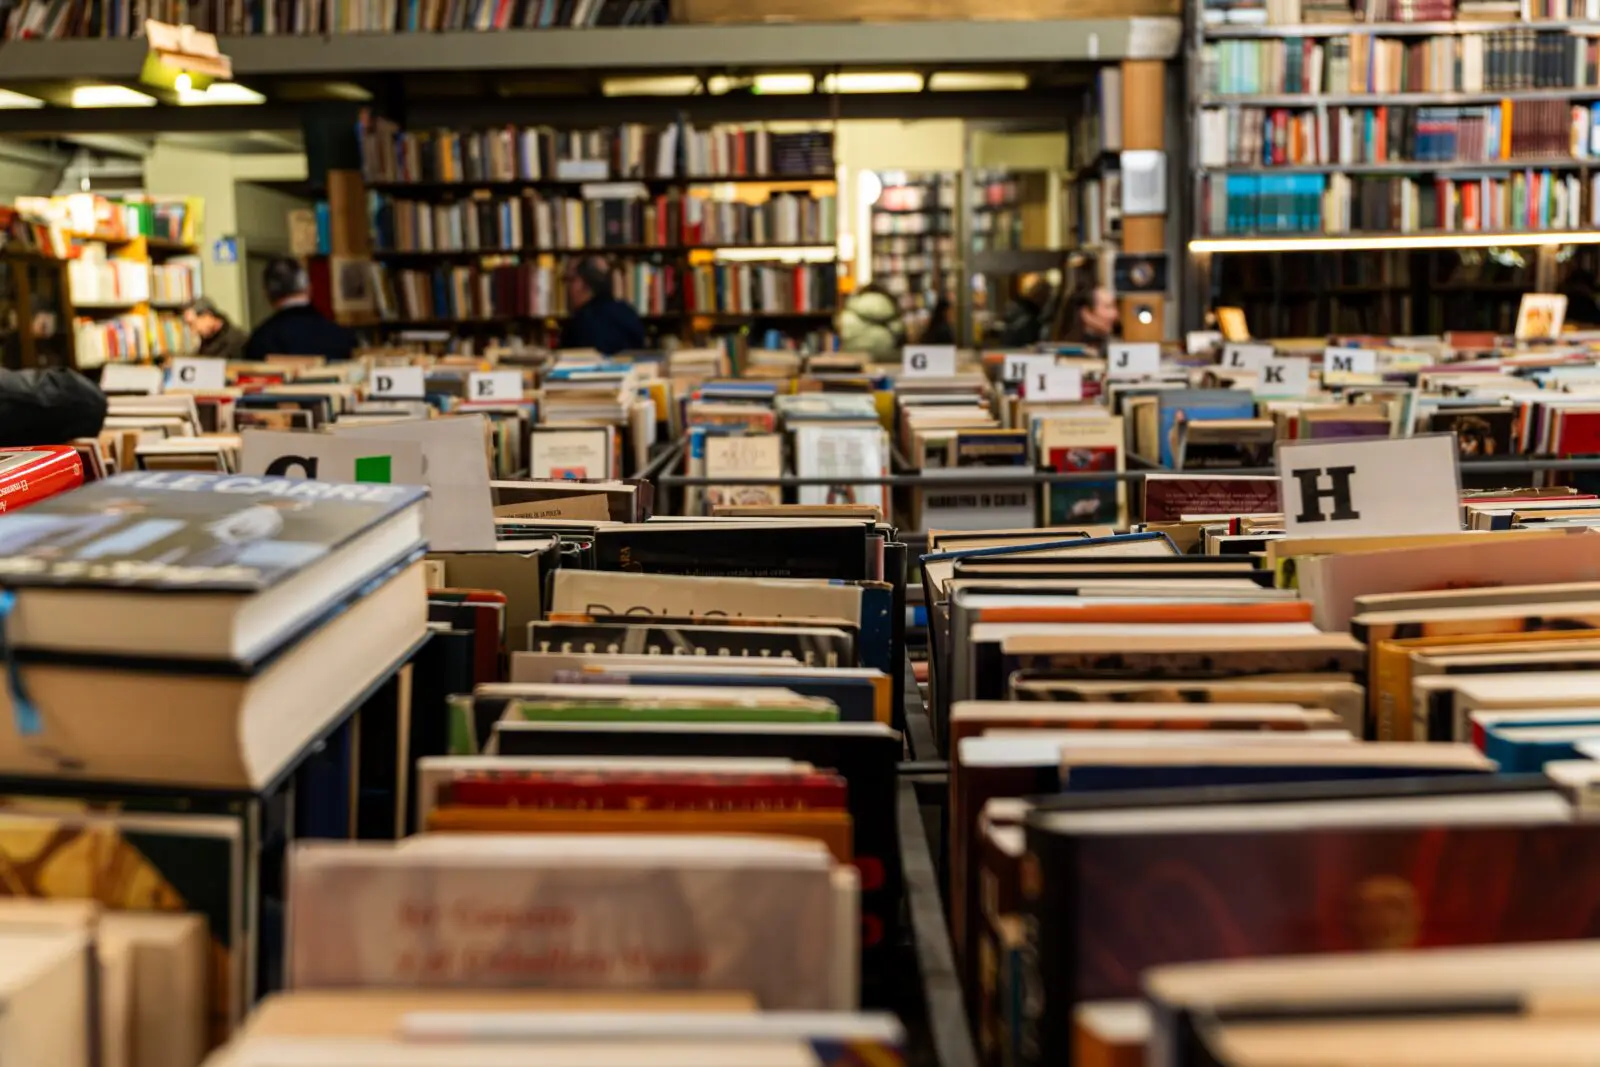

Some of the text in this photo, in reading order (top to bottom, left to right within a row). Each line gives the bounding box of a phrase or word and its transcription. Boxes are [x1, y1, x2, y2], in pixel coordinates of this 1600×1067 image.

[910, 353, 928, 370] G
[1116, 352, 1129, 367] J
[1230, 352, 1245, 368] L
[1332, 356, 1355, 371] M
[179, 365, 196, 383] C
[1264, 365, 1285, 383] K
[376, 376, 393, 392] D
[477, 379, 494, 395] E
[1038, 374, 1047, 391] I
[1292, 465, 1360, 523] H
